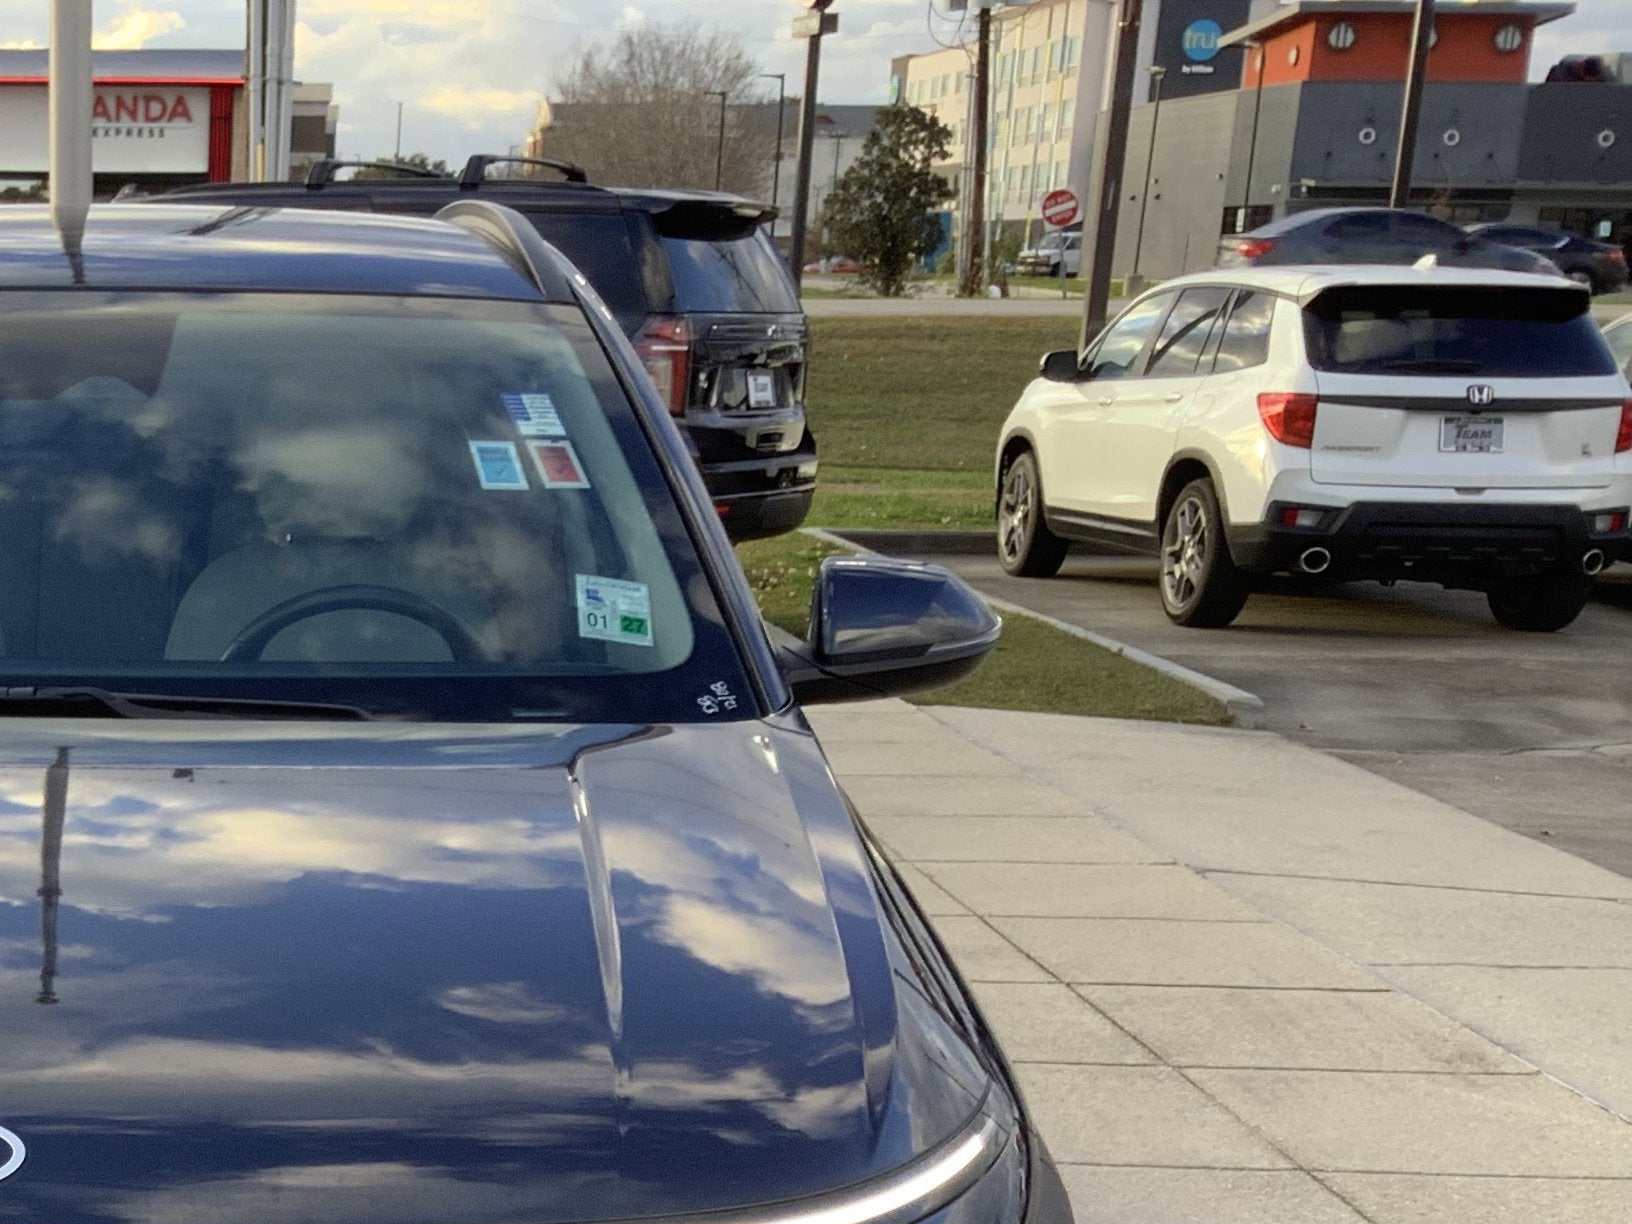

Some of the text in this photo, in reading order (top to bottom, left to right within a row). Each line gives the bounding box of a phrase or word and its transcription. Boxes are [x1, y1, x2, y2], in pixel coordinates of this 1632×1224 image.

[1183, 28, 1219, 49] tru
[92, 93, 193, 123] ANDA
[91, 126, 166, 138] EXPRESS
[586, 612, 646, 634] 01 27
